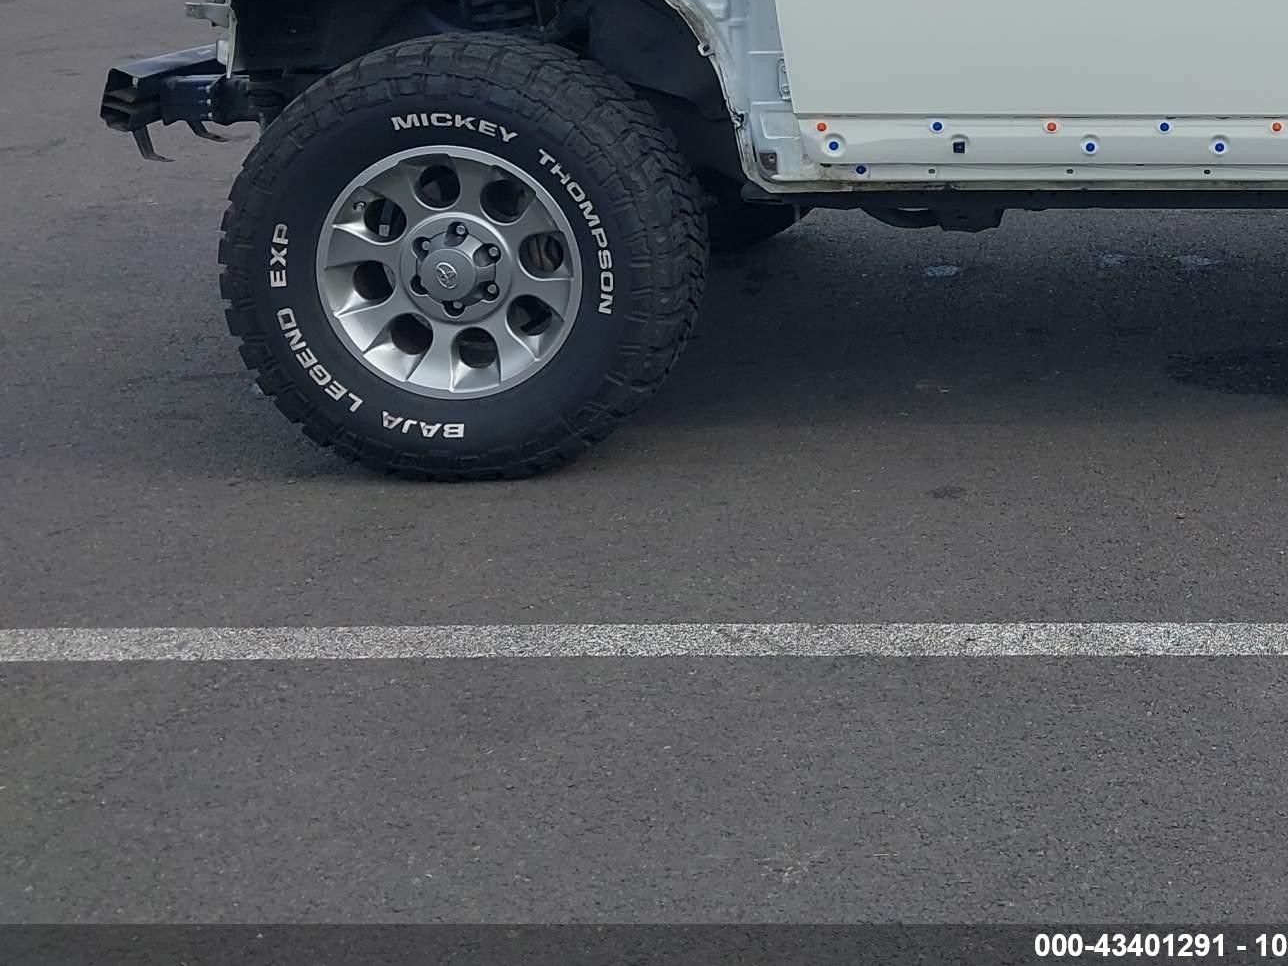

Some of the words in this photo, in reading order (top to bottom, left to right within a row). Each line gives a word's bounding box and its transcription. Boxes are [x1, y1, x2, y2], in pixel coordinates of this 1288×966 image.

[270, 223, 289, 289] EXP
[390, 112, 517, 142] MICKEY
[538, 149, 615, 315] THOMPSON
[276, 307, 363, 413] LEGEND
[381, 411, 465, 438] BAJA
